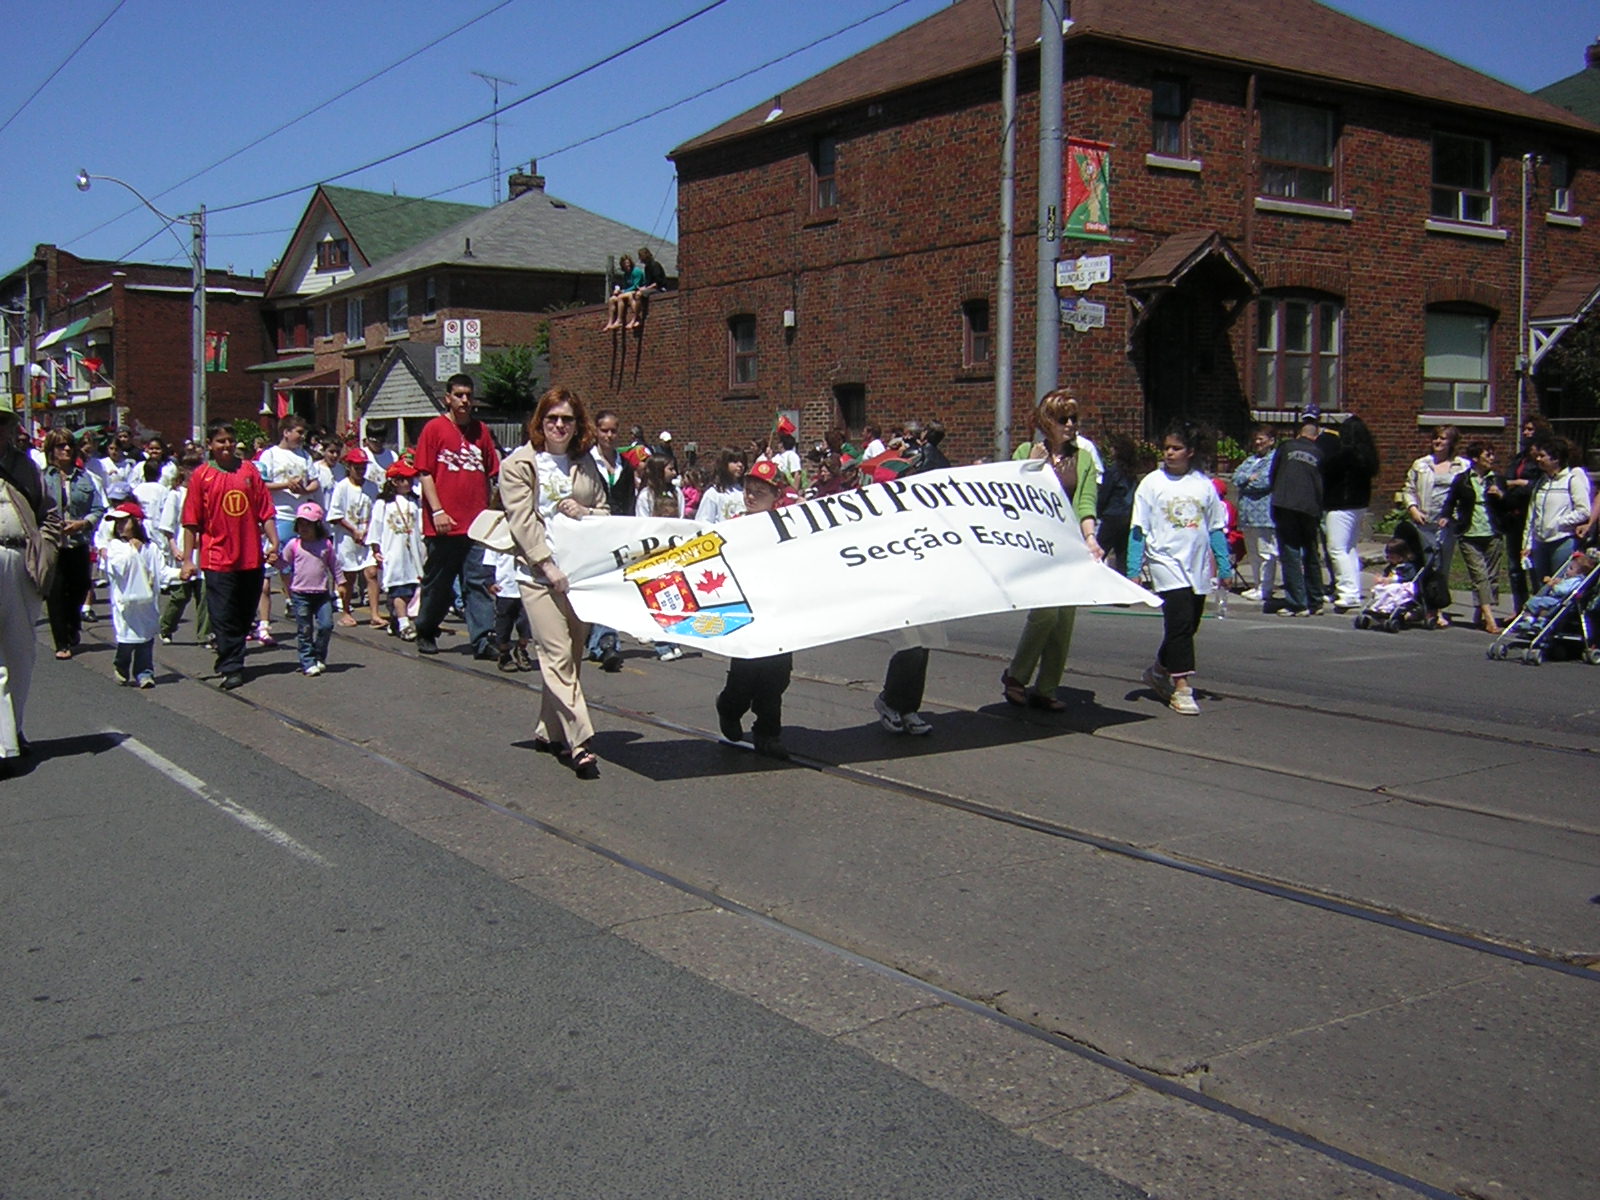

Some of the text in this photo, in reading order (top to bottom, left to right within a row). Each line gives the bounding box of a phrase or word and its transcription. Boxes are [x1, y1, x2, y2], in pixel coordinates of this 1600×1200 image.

[1060, 271, 1085, 285] DUNDAS
[228, 493, 241, 513] 17
[767, 475, 1066, 545] First Portuguese
[839, 525, 1055, 568] Secção Escolar
